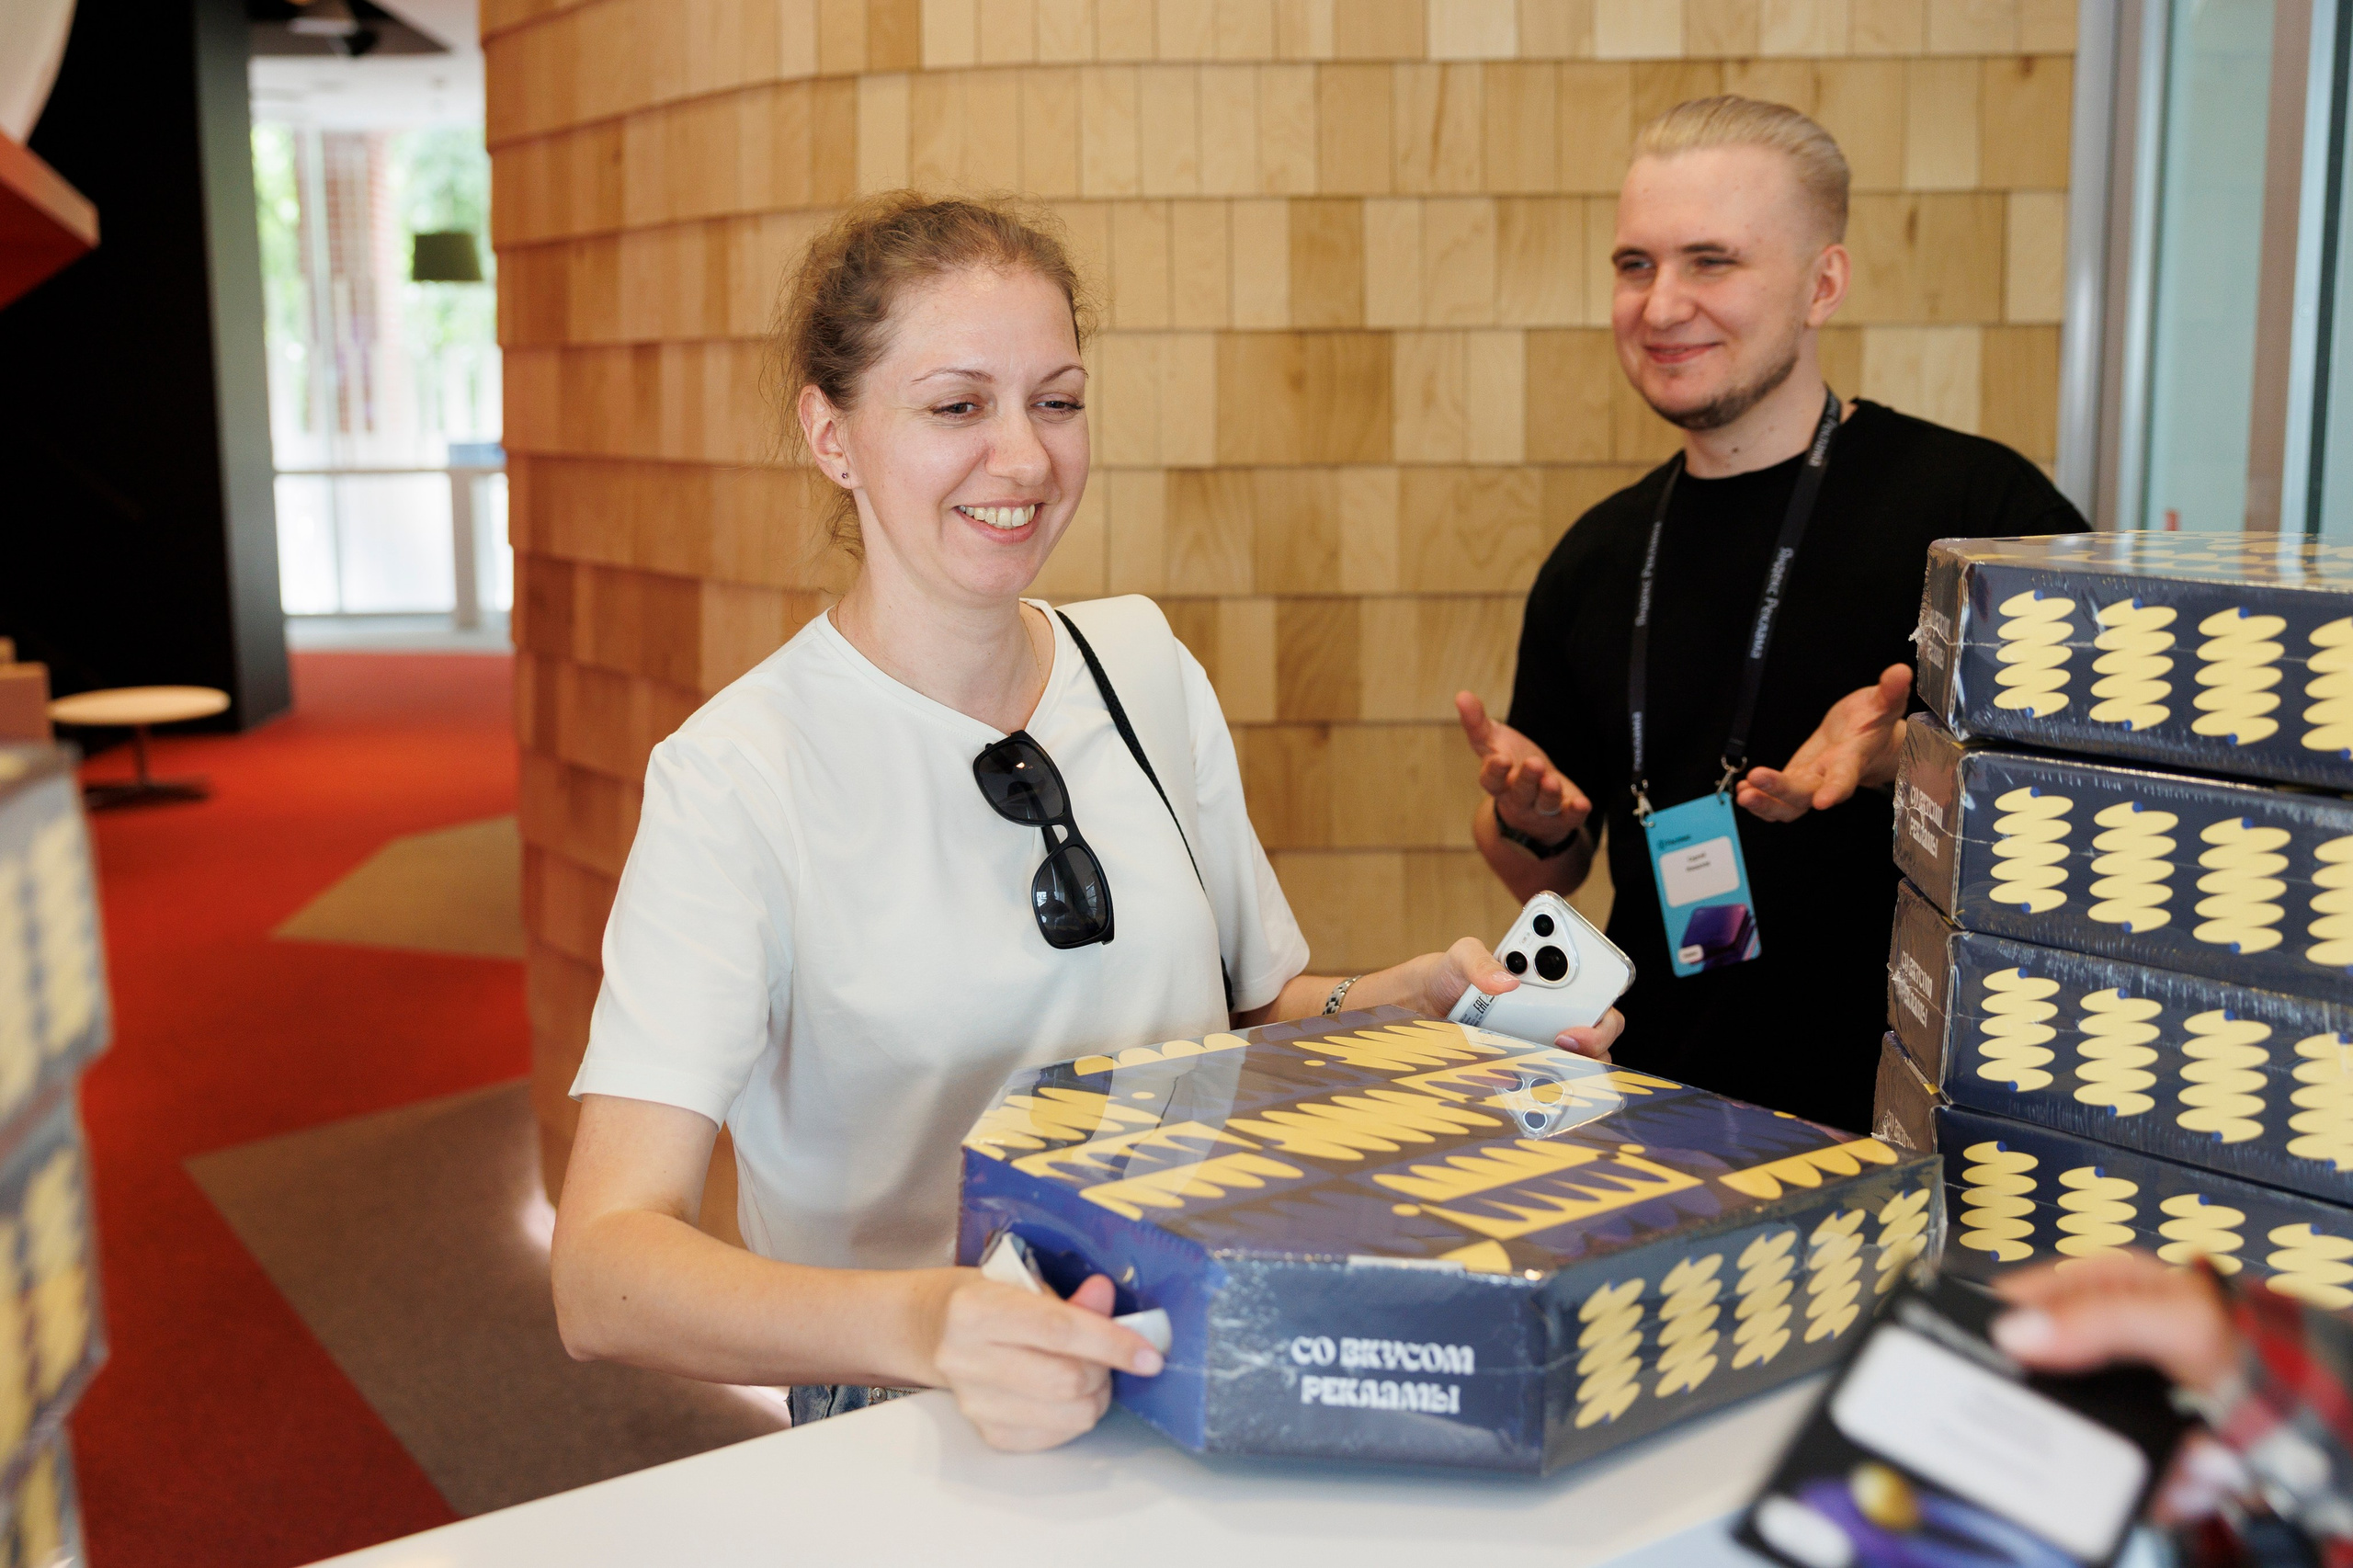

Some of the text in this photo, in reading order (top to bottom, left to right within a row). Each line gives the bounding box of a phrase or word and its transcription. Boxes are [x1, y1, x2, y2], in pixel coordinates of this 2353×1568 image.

[1750, 597, 1779, 659] Реклама
[1290, 1335, 1475, 1376] СО ВКУСОМ
[1301, 1374, 1461, 1415] РЕКЛАМЫ
